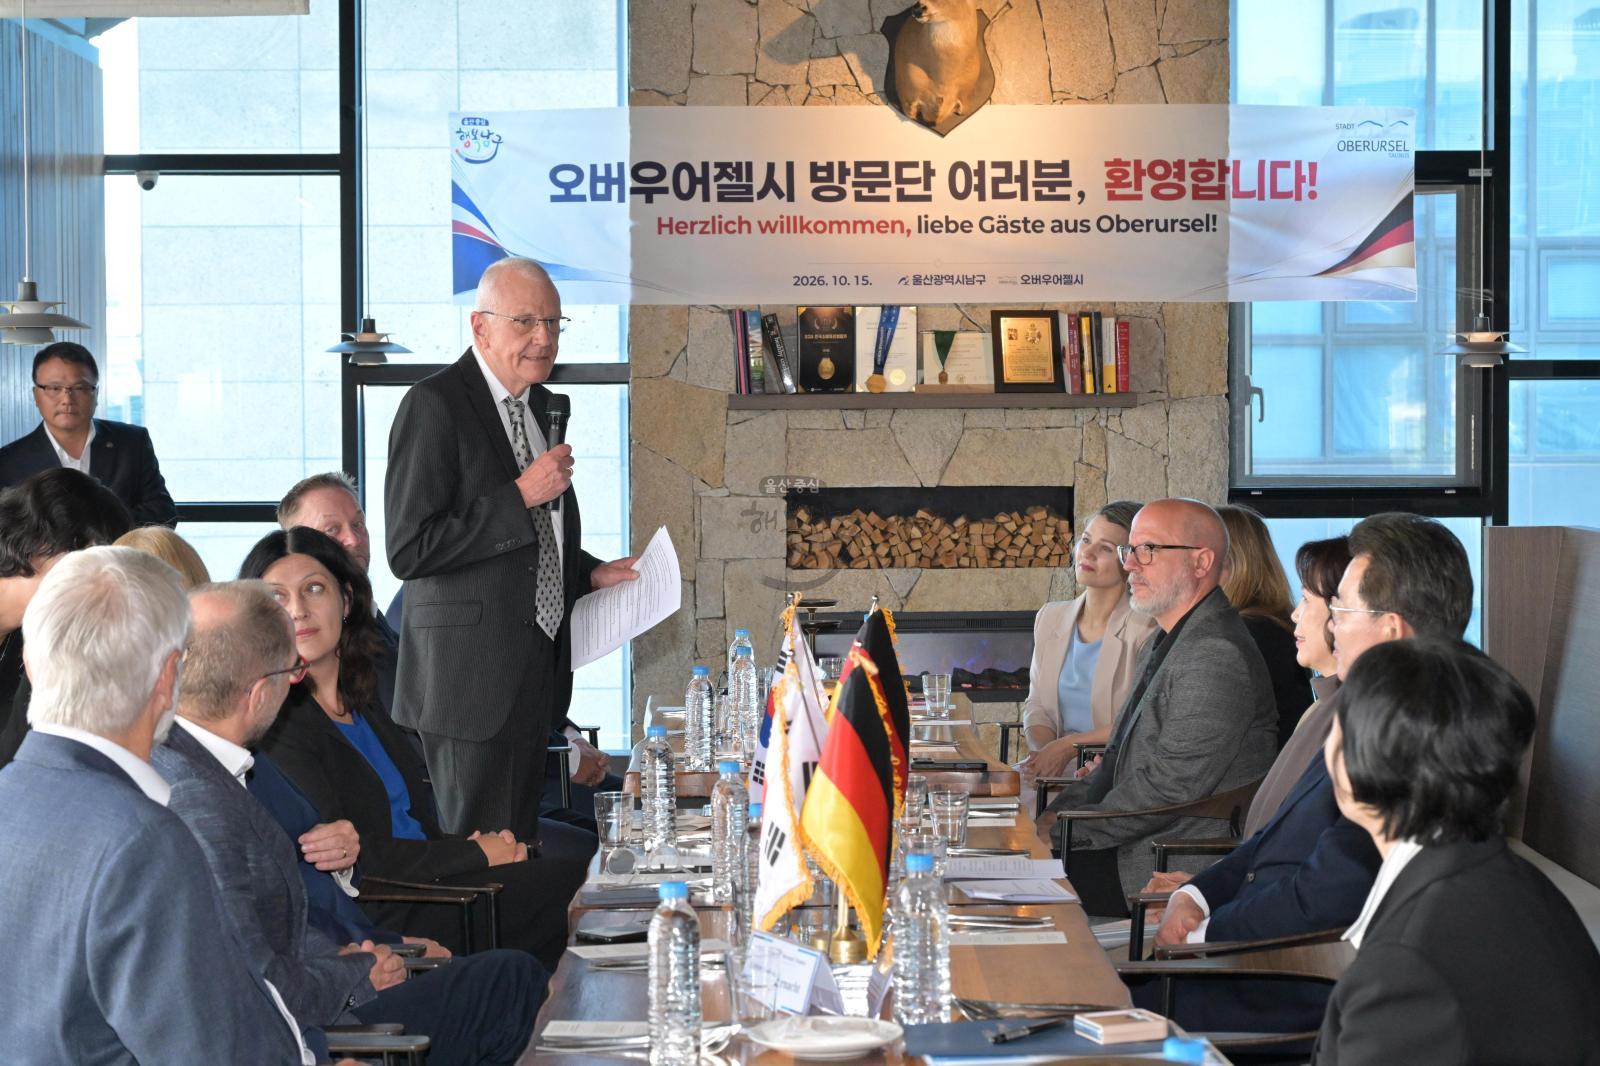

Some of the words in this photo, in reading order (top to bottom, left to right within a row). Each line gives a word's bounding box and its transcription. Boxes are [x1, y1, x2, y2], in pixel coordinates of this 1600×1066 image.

[1337, 139, 1410, 152] OBERURSEL
[549, 160, 795, 204] 오버우어젤시
[810, 159, 937, 203] 방문단
[947, 159, 1086, 206] 여러분,
[1103, 157, 1319, 202] 환영합니다!
[657, 214, 752, 236] Herzlich
[757, 214, 912, 238] willkommen,
[917, 213, 973, 235] liebe
[978, 214, 1046, 235] Gäste
[1051, 218, 1091, 234] aus
[1096, 212, 1218, 234] Oberursel!
[792, 275, 829, 287] 2026.
[832, 275, 850, 287] 10.
[853, 275, 873, 287] 15.
[912, 274, 987, 287] 울산광역시남구
[1020, 273, 1084, 286] 오버우어젤시
